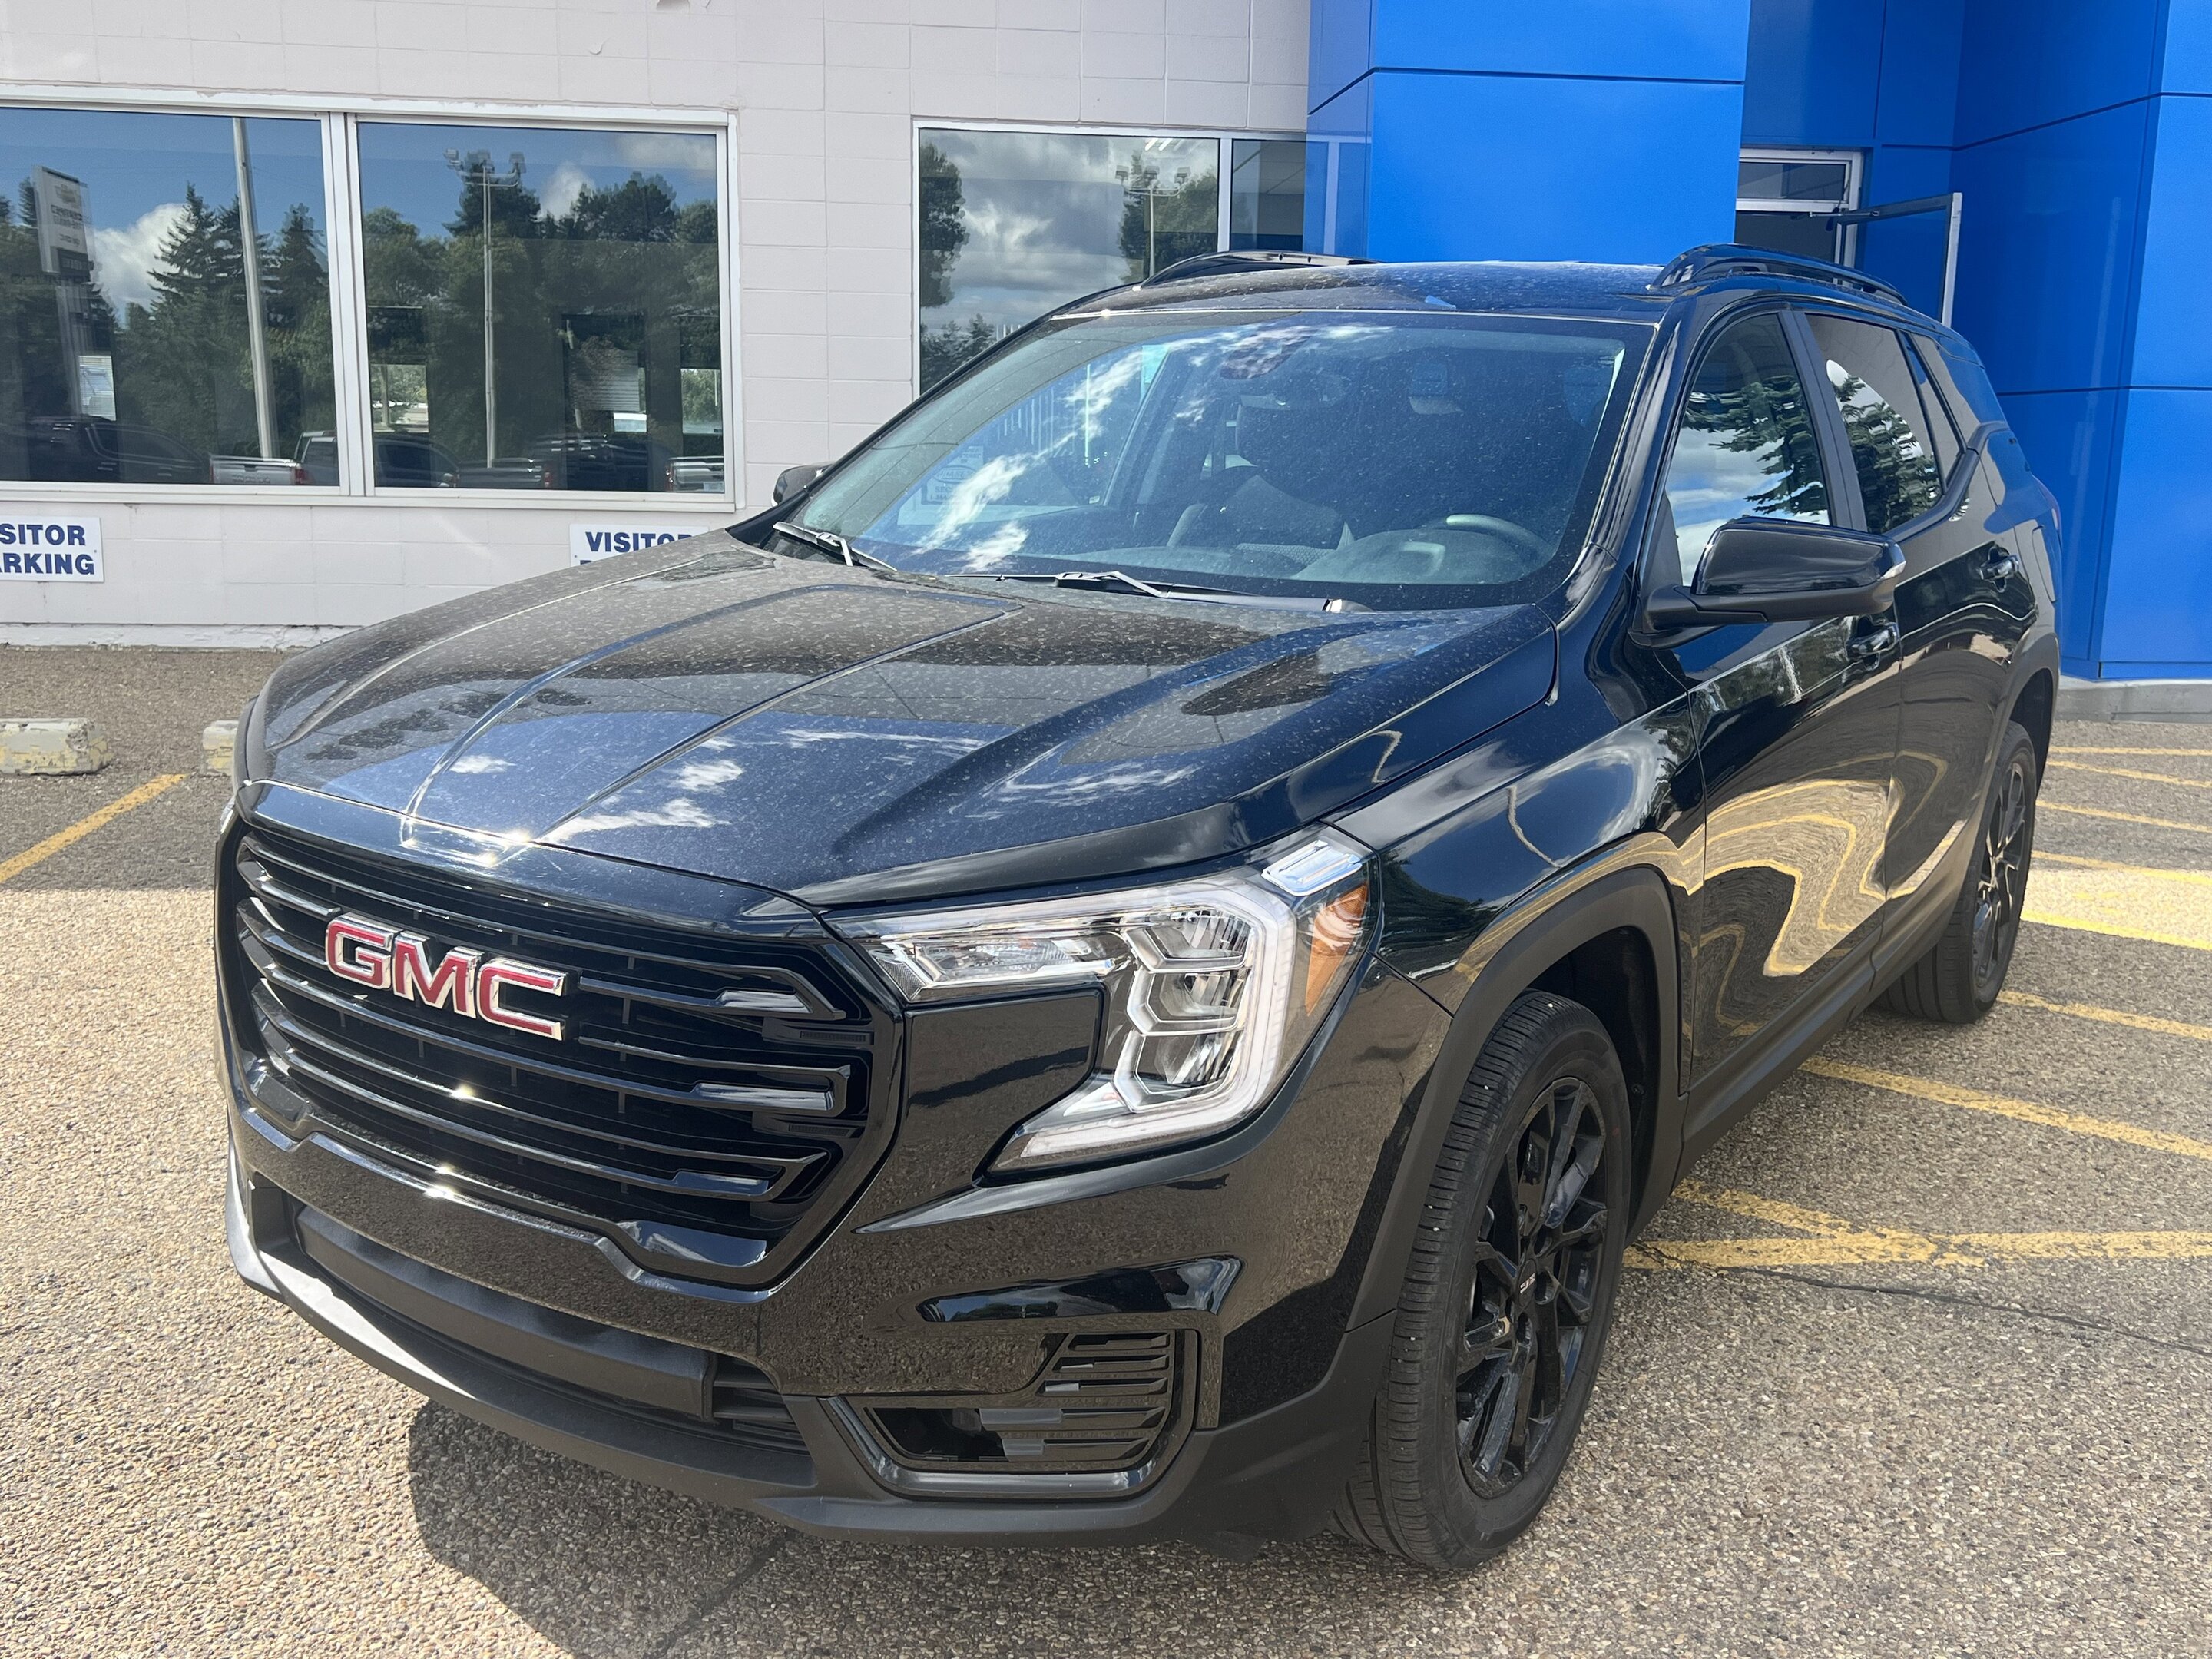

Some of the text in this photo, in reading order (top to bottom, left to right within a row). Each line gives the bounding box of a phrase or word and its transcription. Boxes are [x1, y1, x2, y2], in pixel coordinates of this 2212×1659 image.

[585, 531, 693, 552] VISIT
[0, 552, 94, 575] RKING
[325, 912, 567, 1041] GMC
